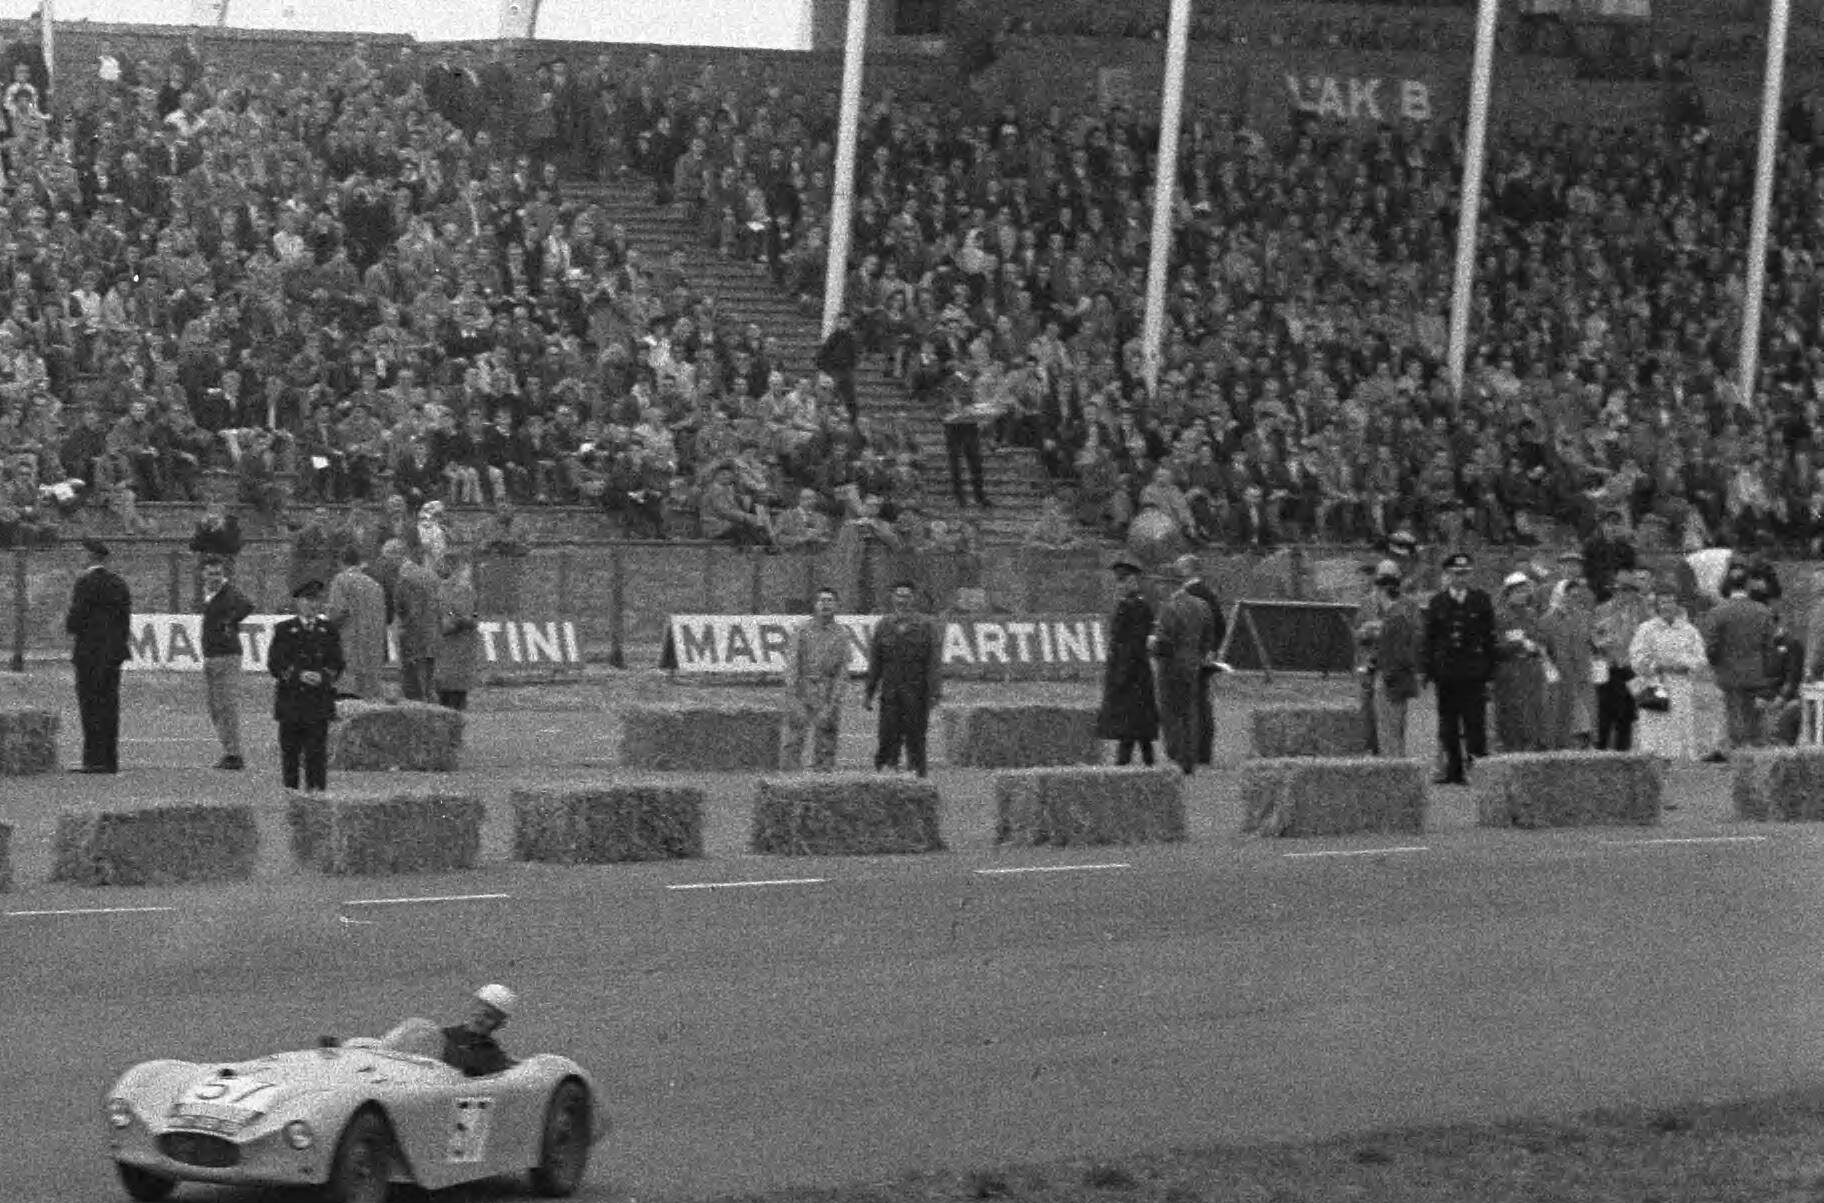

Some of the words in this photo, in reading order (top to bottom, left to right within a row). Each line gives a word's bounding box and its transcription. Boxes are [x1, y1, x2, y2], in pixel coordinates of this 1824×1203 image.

[1401, 78, 1432, 121] B
[477, 621, 579, 662] TINI
[941, 621, 1107, 664] ARTINI
